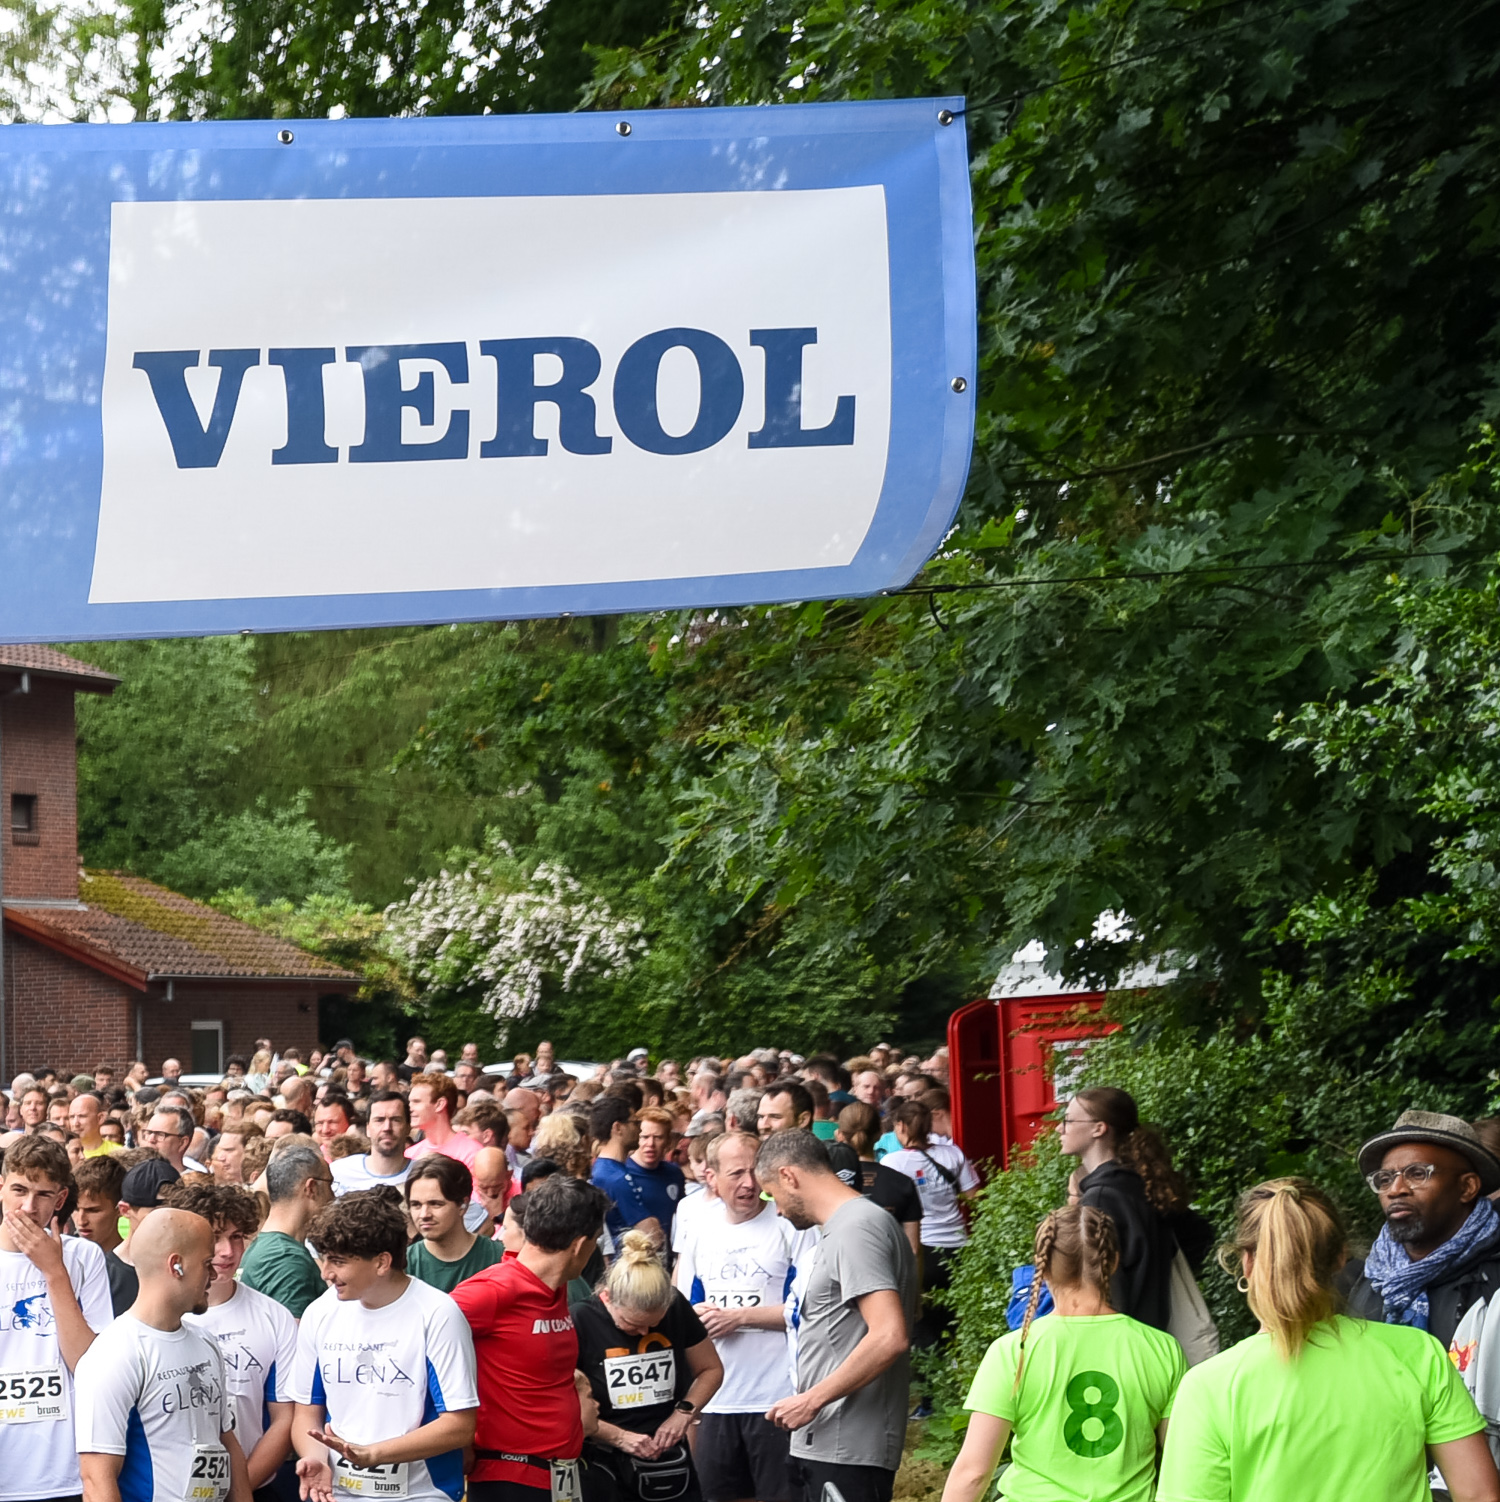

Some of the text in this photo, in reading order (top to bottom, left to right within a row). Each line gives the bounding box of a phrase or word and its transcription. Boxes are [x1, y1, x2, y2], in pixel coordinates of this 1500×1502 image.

[133, 325, 856, 470] VIEROL
[322, 1357, 416, 1386] ELENA
[609, 1360, 673, 1389] 2647
[617, 1392, 644, 1405] EWE
[37, 1405, 61, 1416] bruns
[1063, 1370, 1124, 1459] 8
[191, 1455, 229, 1479] 2521
[192, 1486, 215, 1499] EWE
[338, 1475, 363, 1491] EWE
[374, 1480, 401, 1492] bruns
